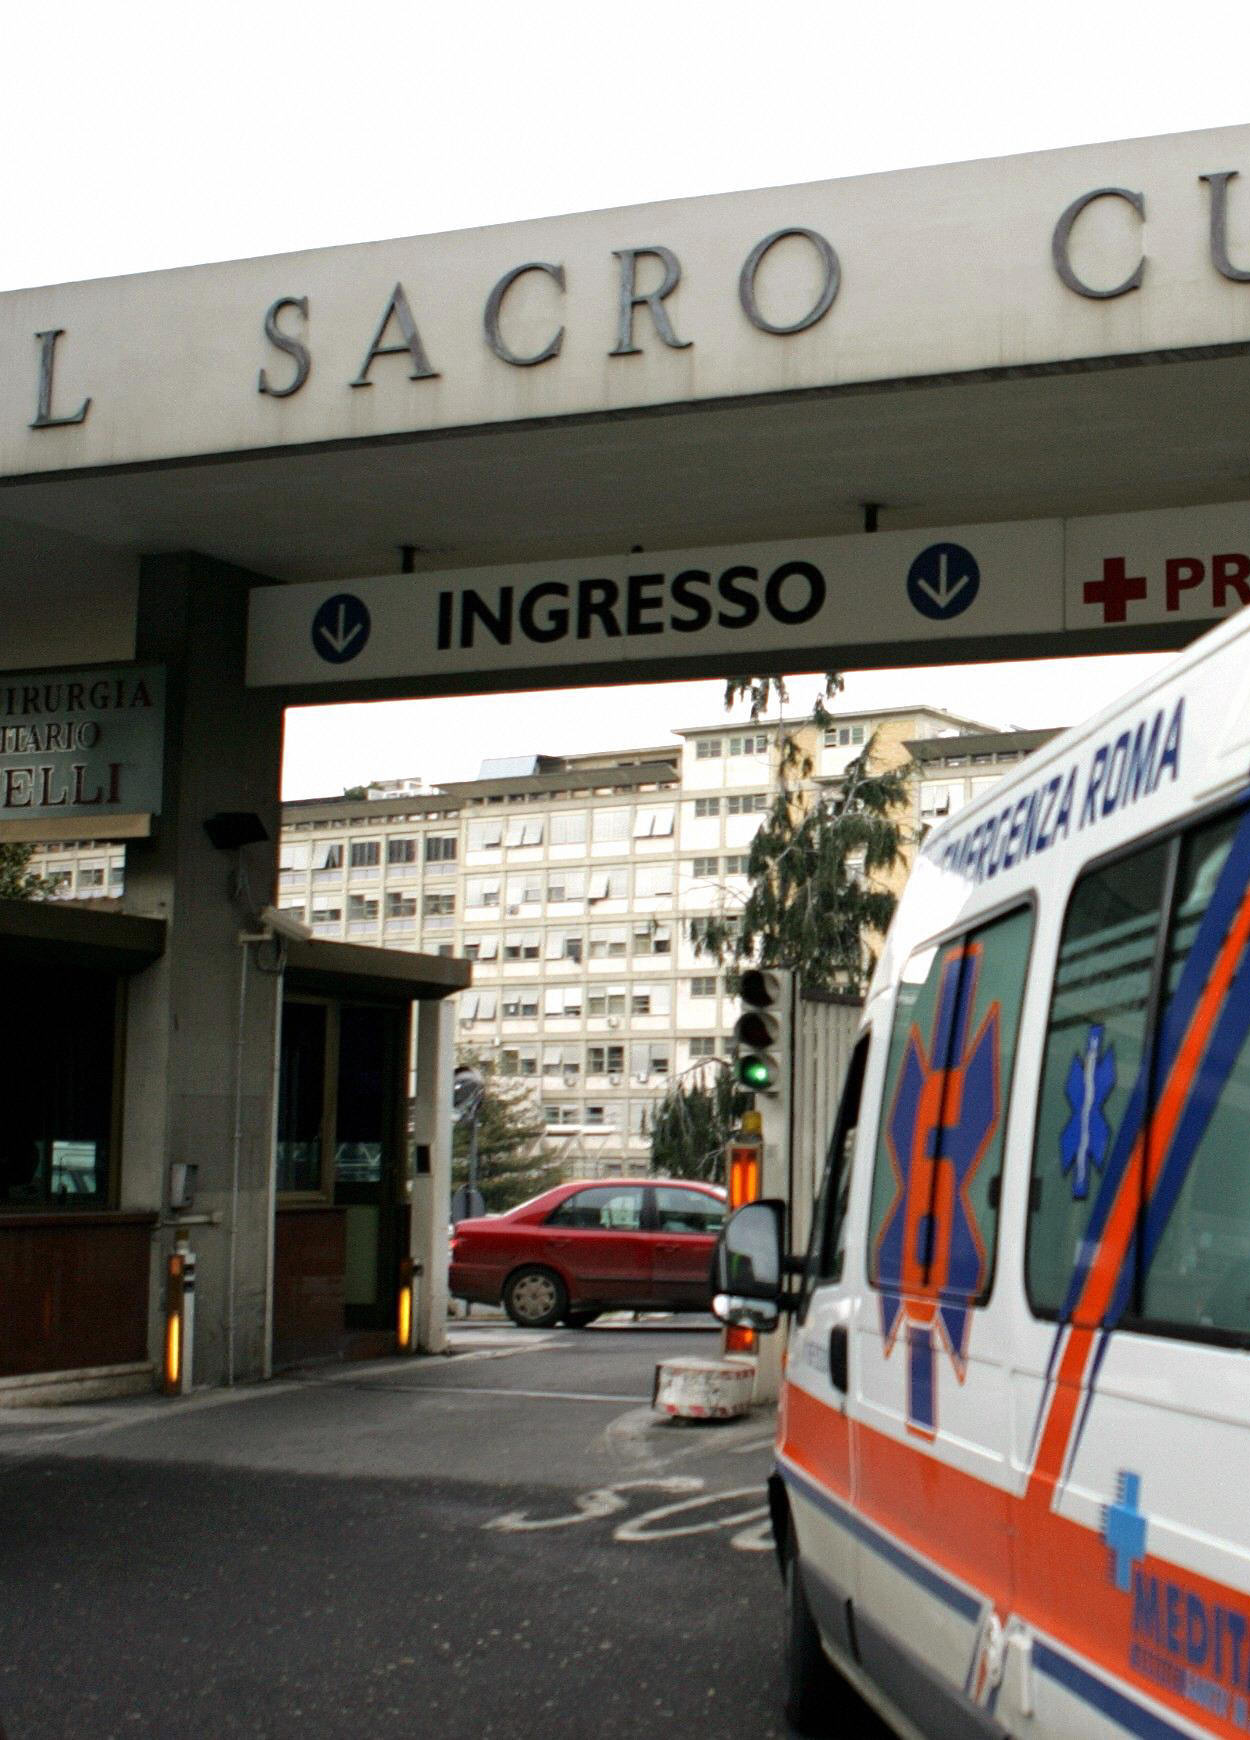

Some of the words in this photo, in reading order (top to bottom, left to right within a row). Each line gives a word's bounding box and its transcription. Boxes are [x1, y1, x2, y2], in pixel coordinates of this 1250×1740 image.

[27, 329, 92, 430] L
[258, 227, 842, 398] SACRO
[437, 561, 827, 651] INGRESSO
[6, 678, 155, 716] IRURGIA
[0, 721, 102, 754] ITARIO
[1079, 696, 1185, 832] ROMA
[3, 763, 124, 809] ELLI
